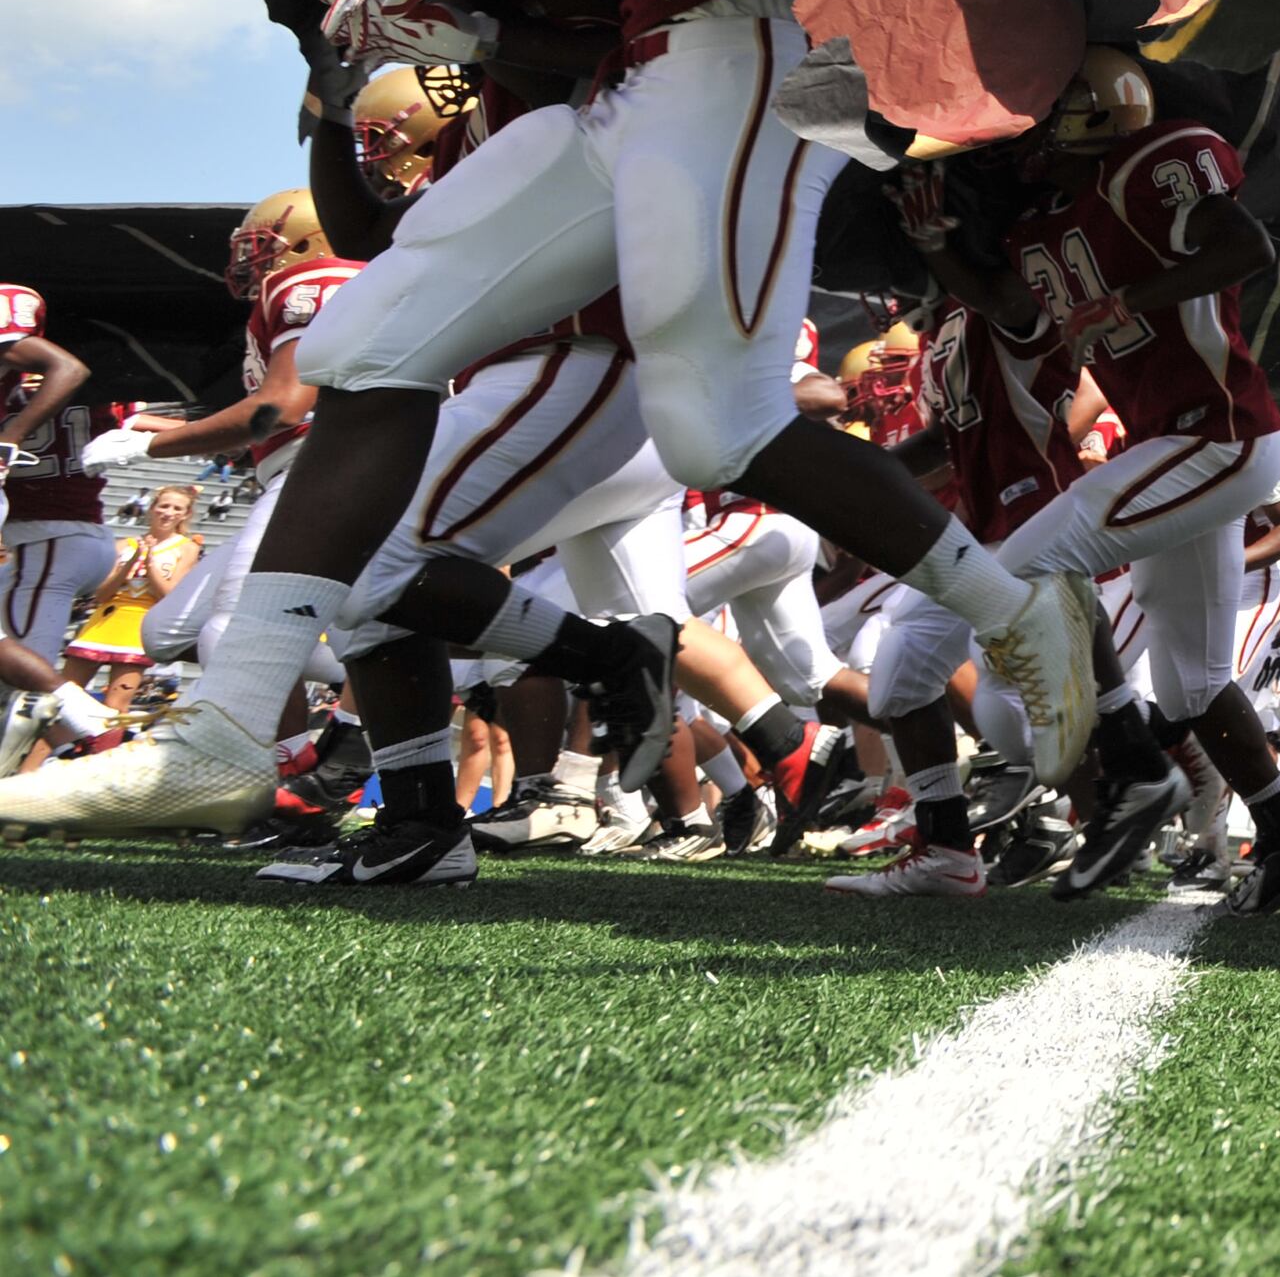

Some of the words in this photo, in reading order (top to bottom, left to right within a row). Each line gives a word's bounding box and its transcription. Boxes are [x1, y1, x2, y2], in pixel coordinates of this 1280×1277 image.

[1152, 147, 1229, 209] 31
[283, 284, 346, 325] 5
[1020, 226, 1158, 360] 31
